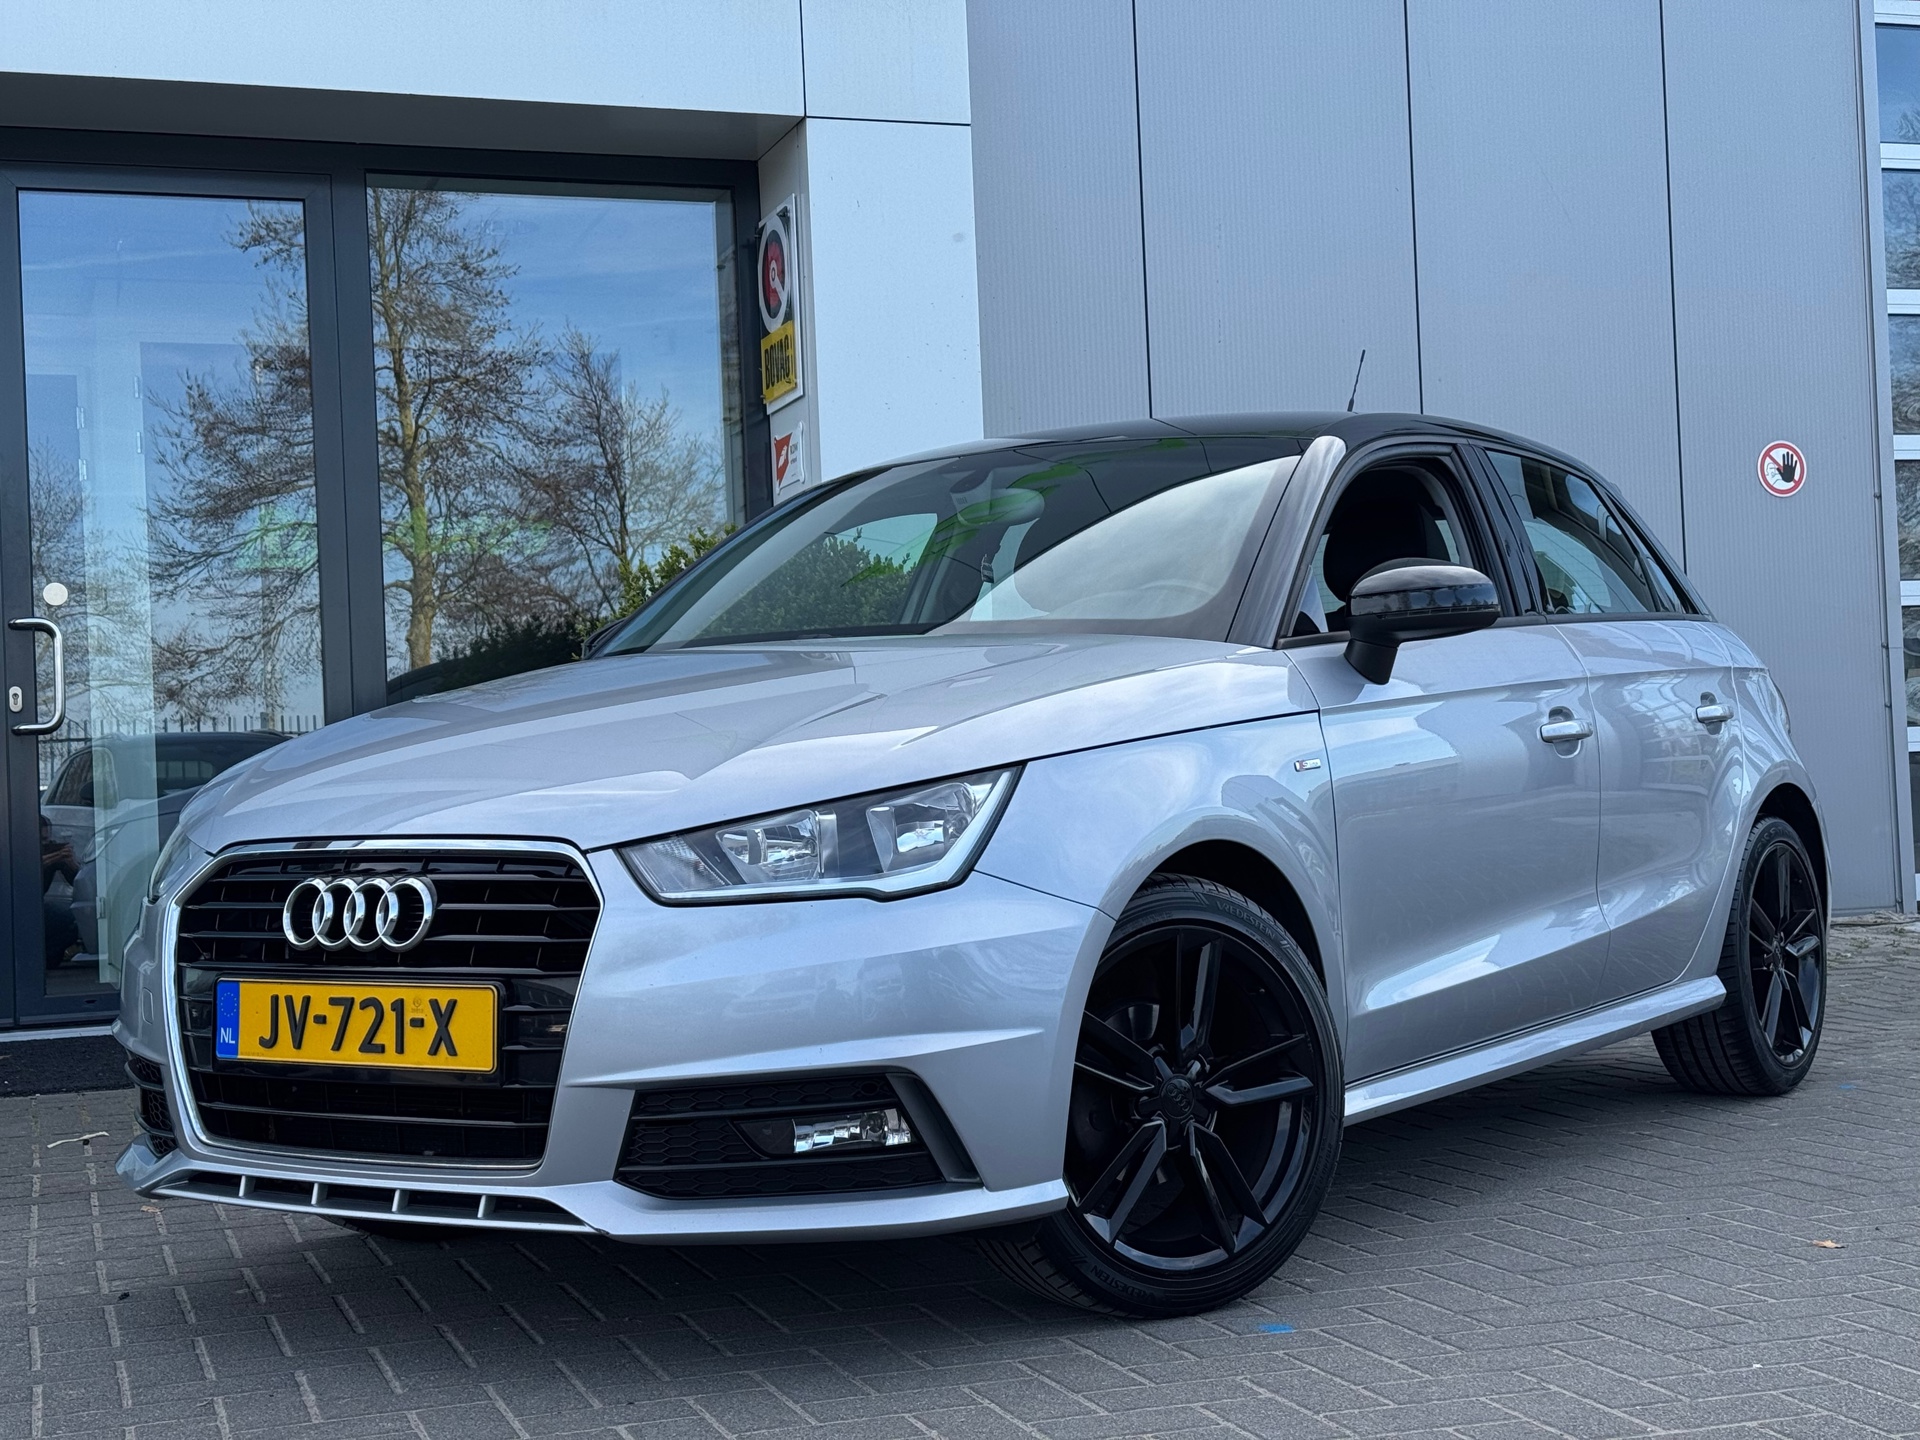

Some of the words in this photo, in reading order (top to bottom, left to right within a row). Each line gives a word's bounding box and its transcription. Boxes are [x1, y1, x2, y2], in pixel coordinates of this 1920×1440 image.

[764, 334, 790, 390] BOVAG
[1216, 902, 1275, 940] VREDESTEIN
[220, 1027, 236, 1044] NL
[258, 994, 458, 1057] JV-721-X
